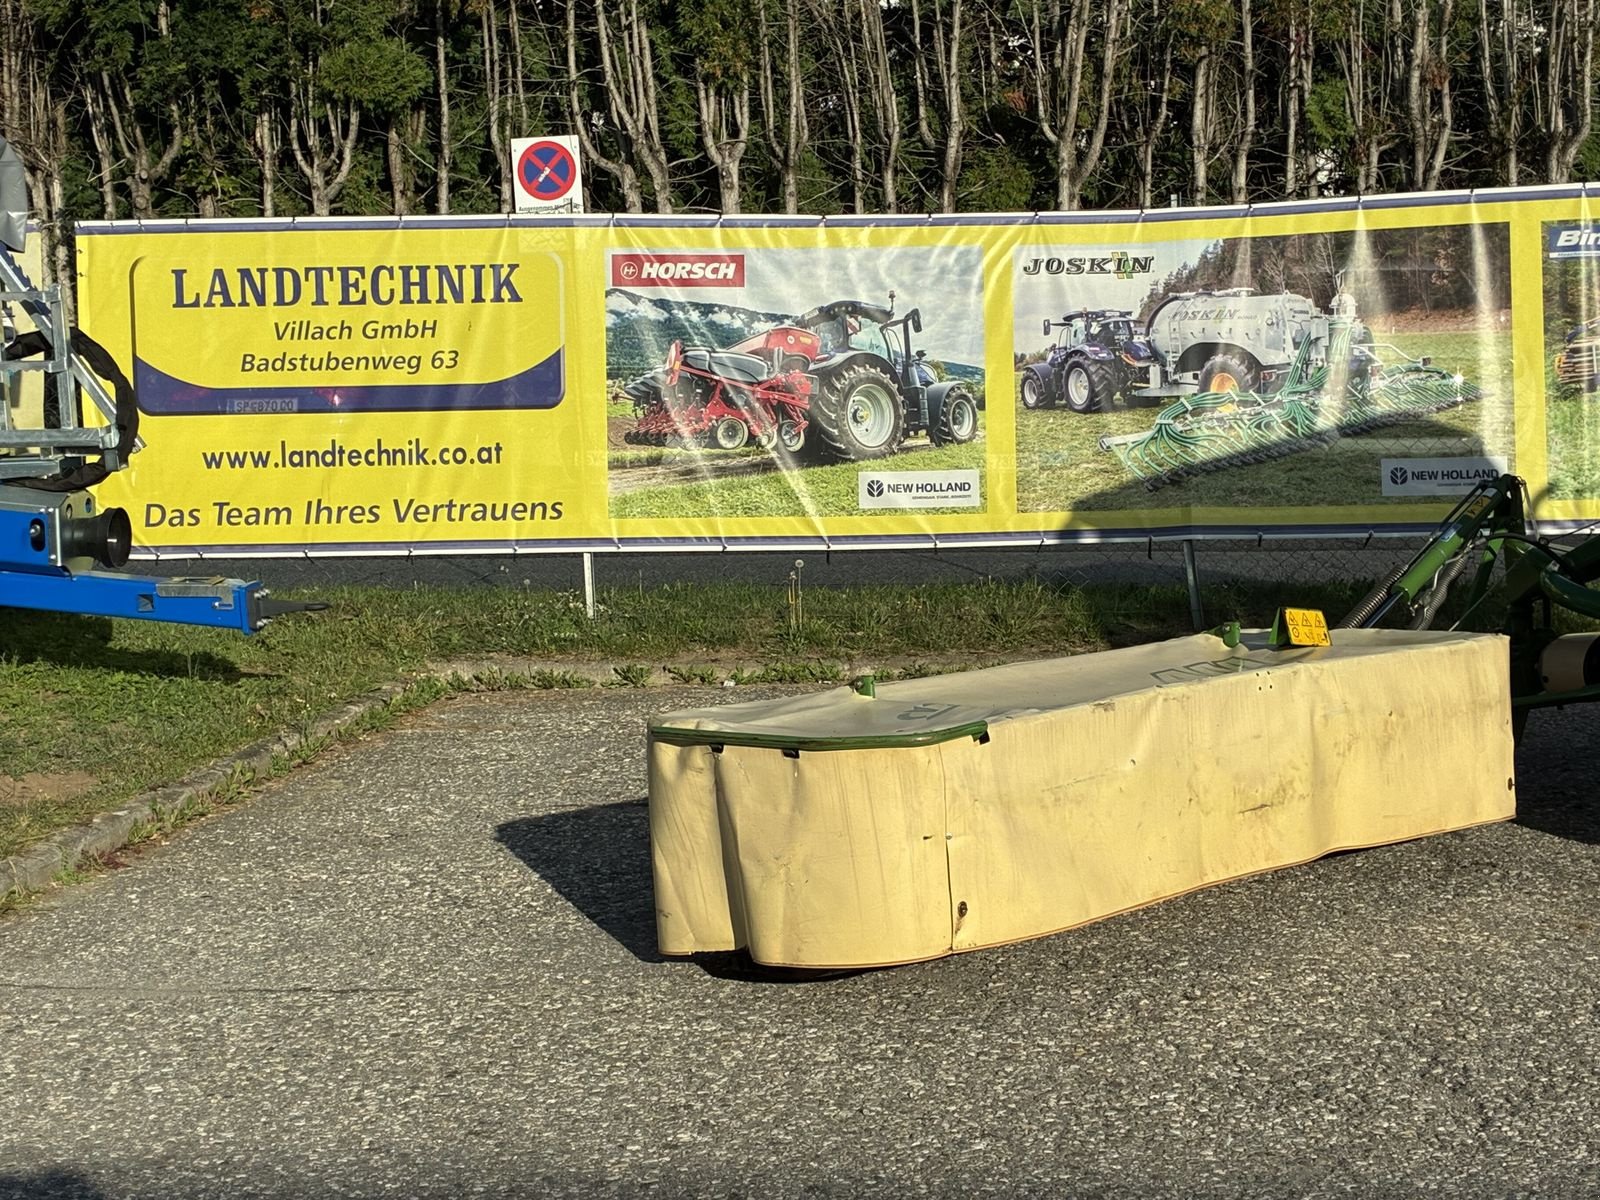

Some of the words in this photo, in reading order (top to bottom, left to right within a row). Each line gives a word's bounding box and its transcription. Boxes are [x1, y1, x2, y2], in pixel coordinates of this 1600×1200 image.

[641, 262, 737, 279] HORSCH
[1023, 255, 1155, 275] JOSKIN
[171, 263, 523, 308] LANDTECHNIK
[274, 320, 352, 341] Villach
[362, 319, 438, 339] GmbH
[240, 351, 422, 375] Badstubenweg
[431, 350, 460, 369] 63
[202, 438, 503, 469] www.landtechnik.co.at
[1411, 470, 1439, 481] NEW
[1441, 468, 1500, 481] HOLLAND
[887, 483, 914, 494] NEW
[916, 481, 972, 493] HOLLAND
[144, 503, 201, 528] Das
[212, 502, 292, 526] Team
[304, 498, 381, 525] Ihres
[392, 498, 564, 523] Vertrauens
